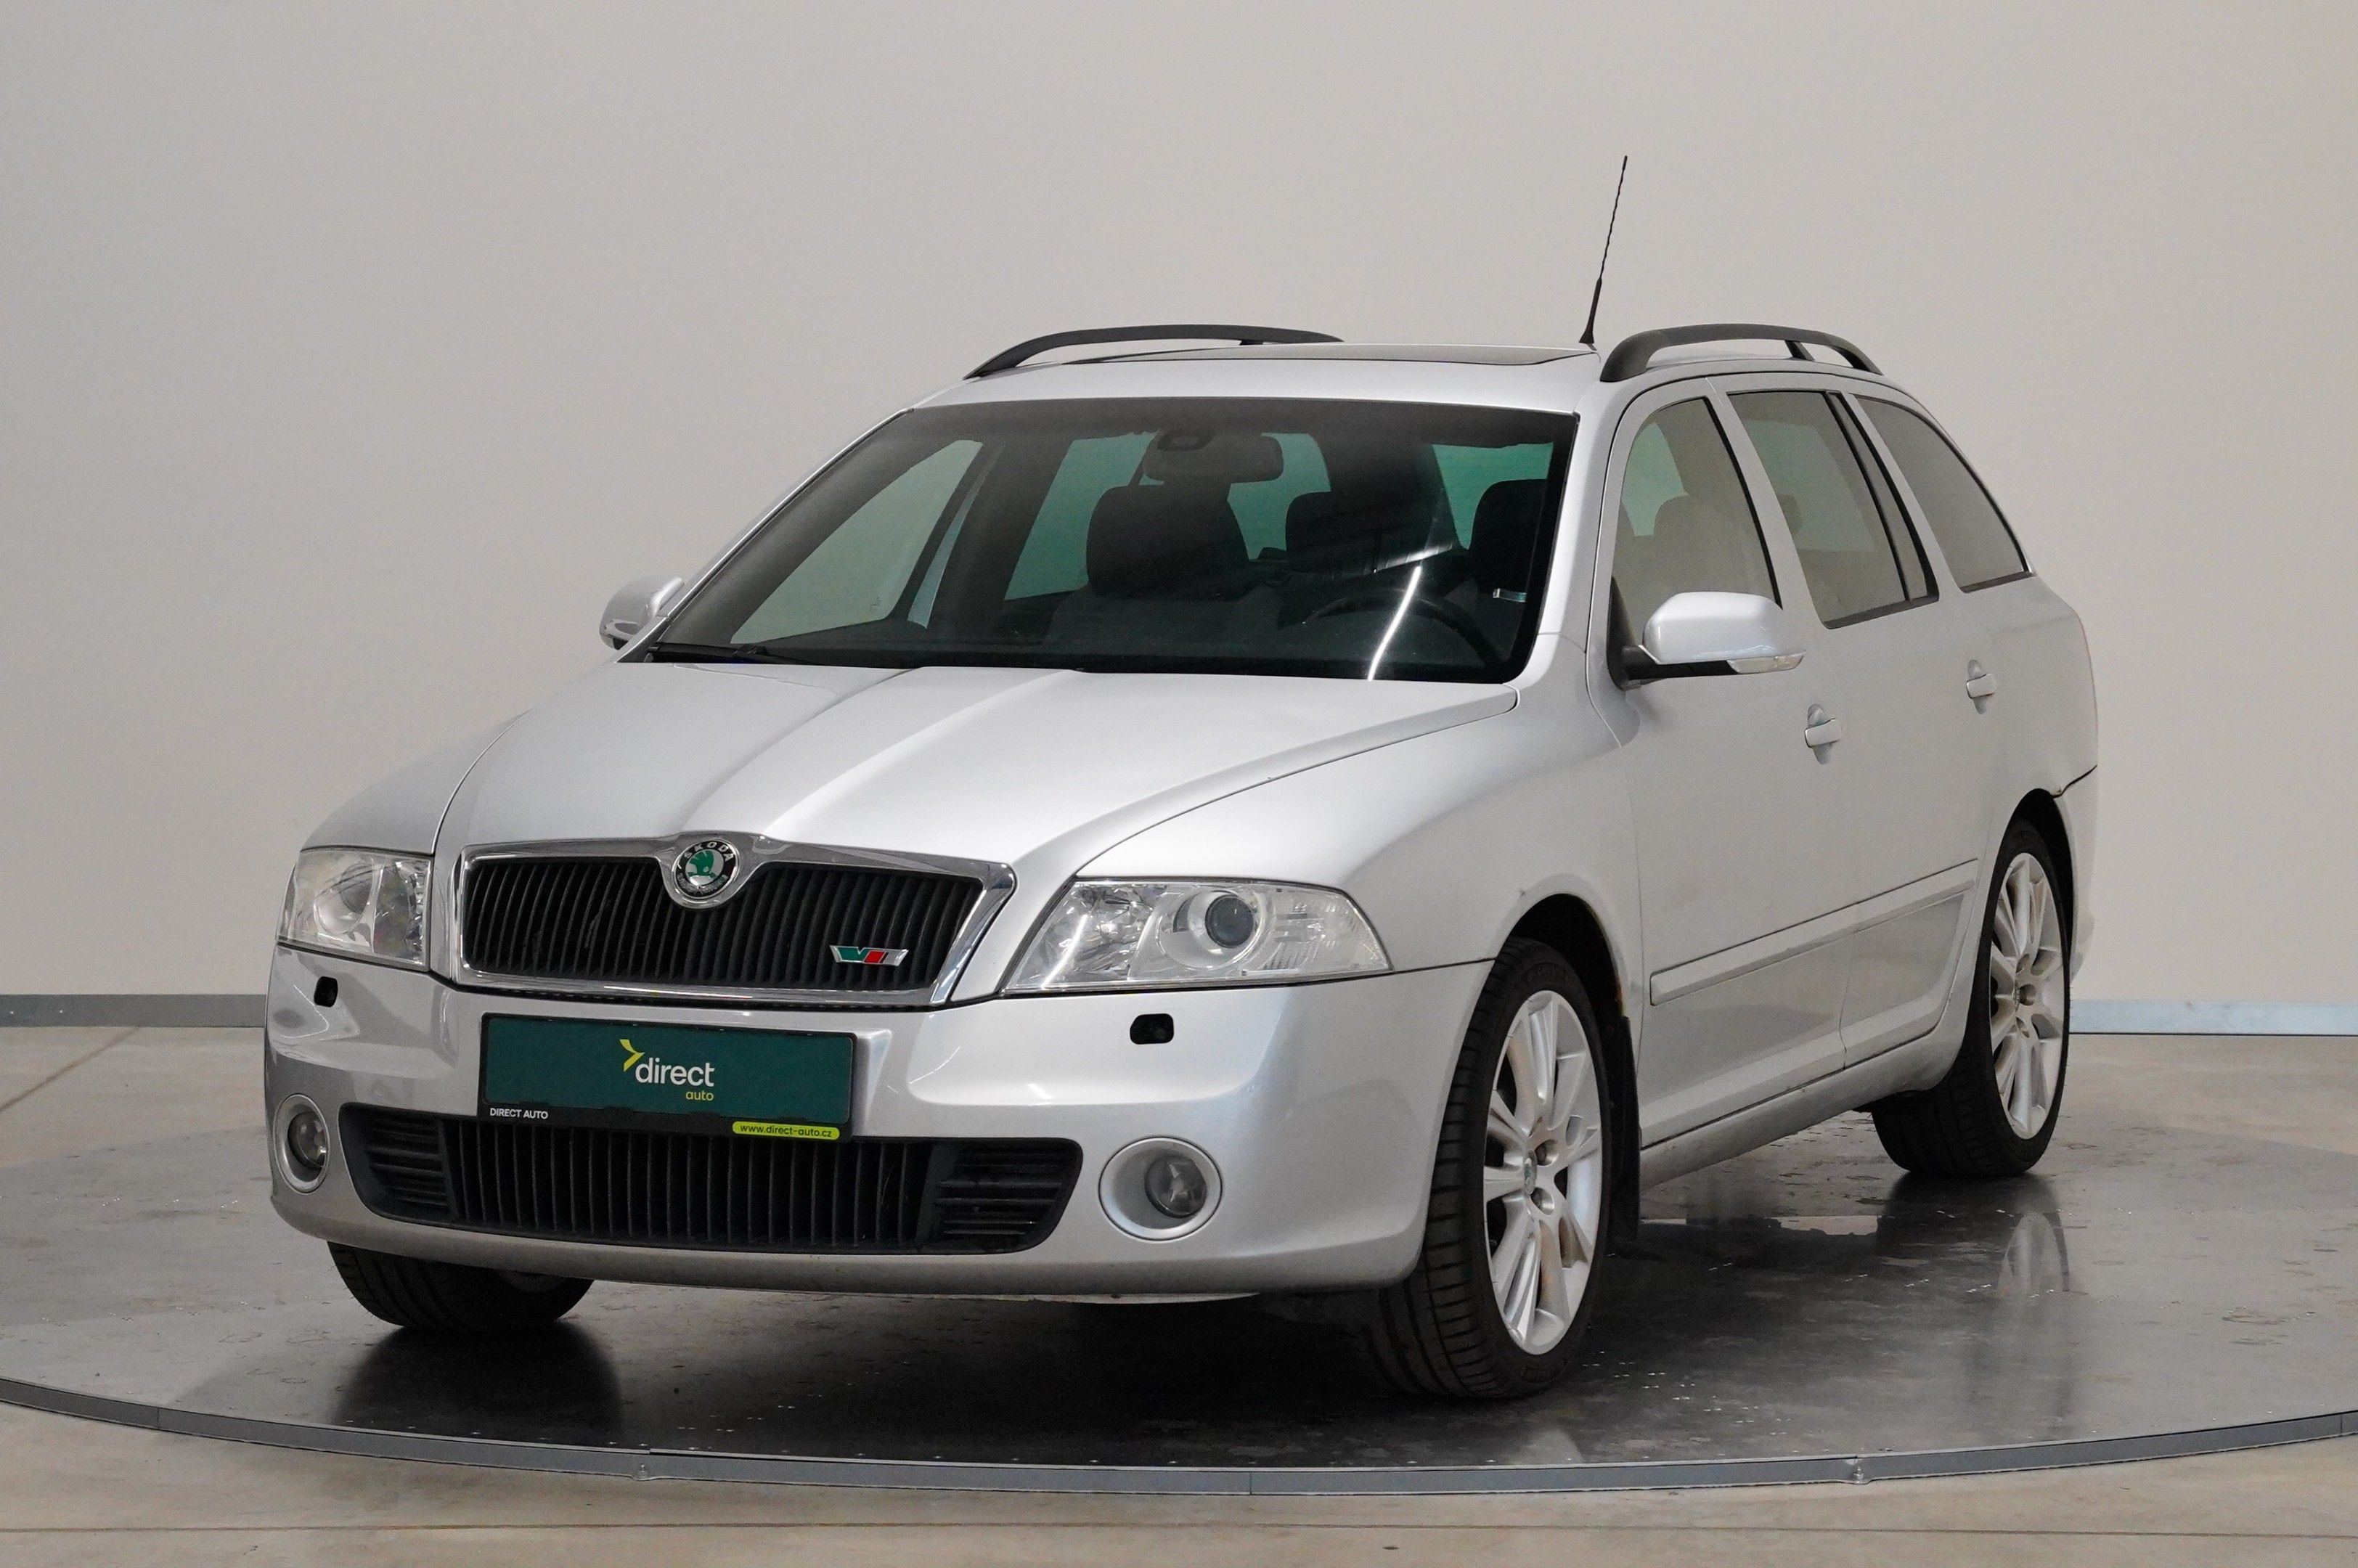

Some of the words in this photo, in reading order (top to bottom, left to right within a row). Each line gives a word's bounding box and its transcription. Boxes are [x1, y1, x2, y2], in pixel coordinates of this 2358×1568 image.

[635, 1057, 715, 1087] direct
[685, 1090, 714, 1101] auto
[489, 1107, 523, 1118] DIRECT
[523, 1109, 549, 1119] AUTO
[740, 1124, 832, 1138] www.direct-auto.cz
